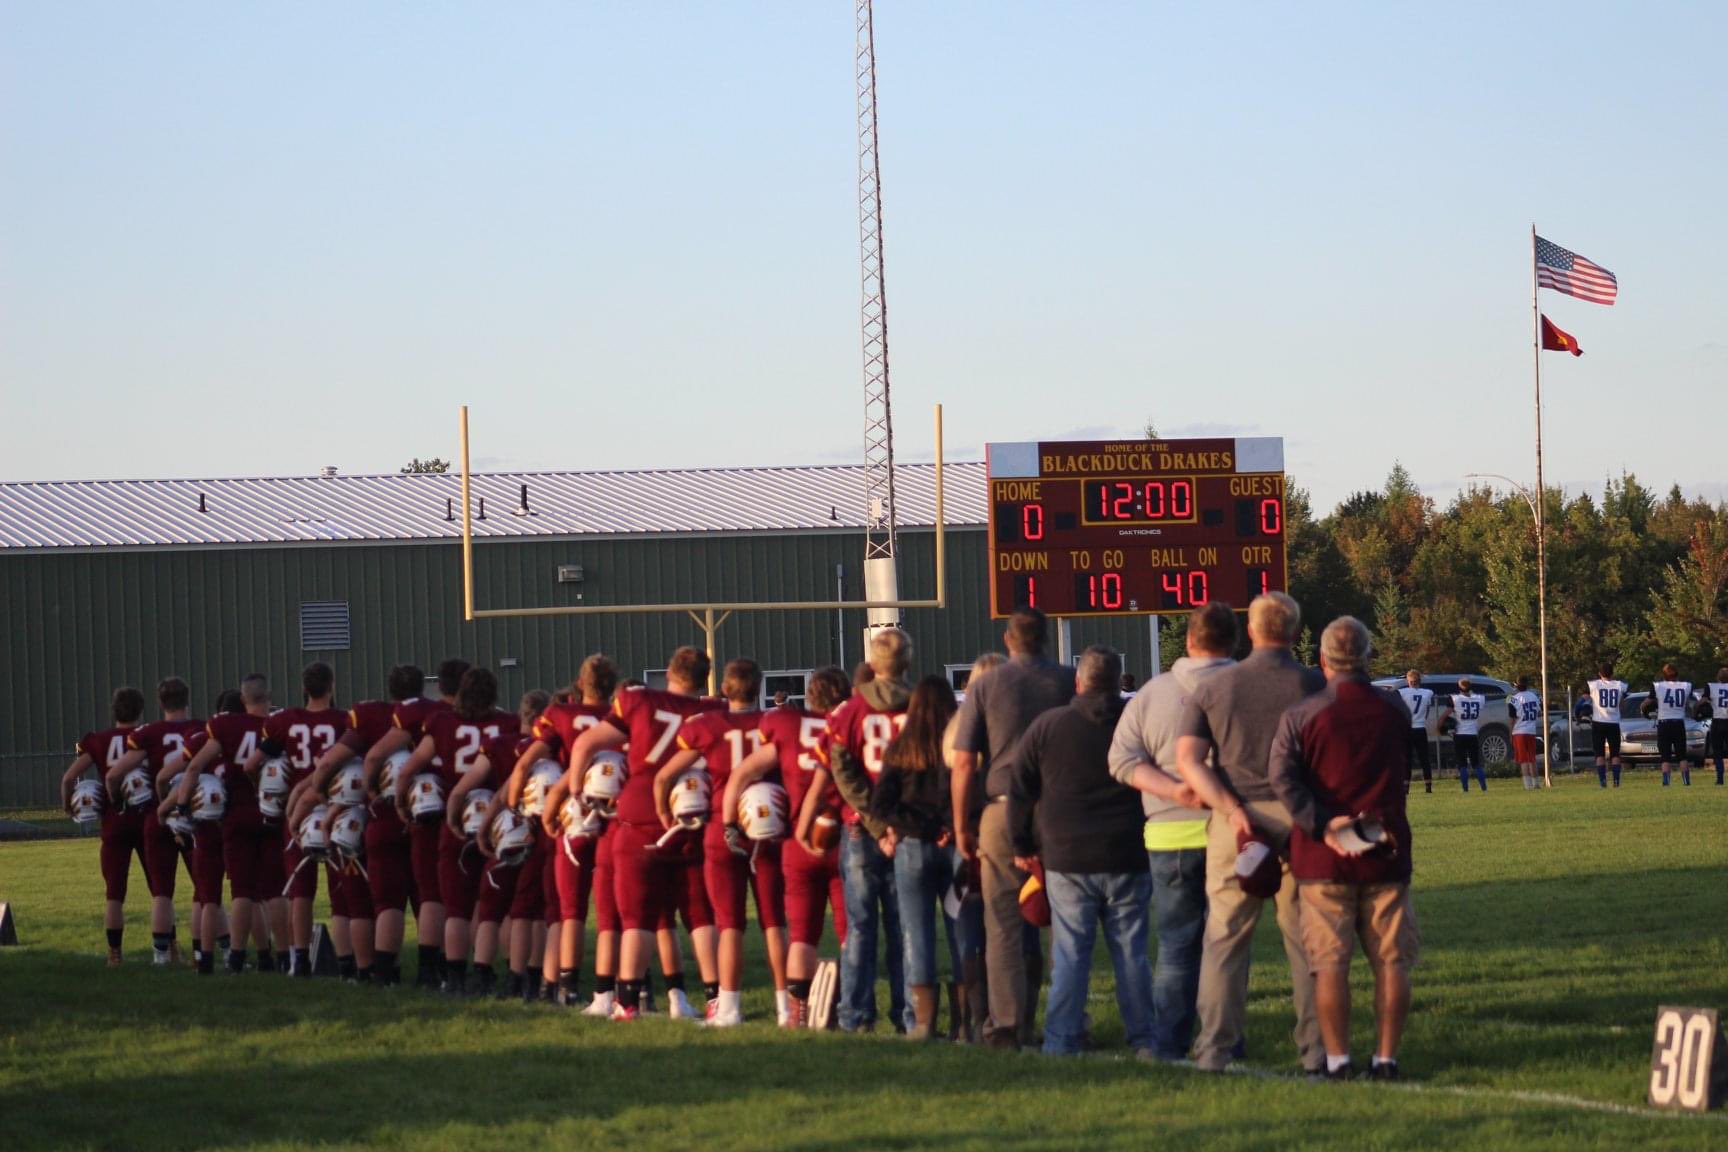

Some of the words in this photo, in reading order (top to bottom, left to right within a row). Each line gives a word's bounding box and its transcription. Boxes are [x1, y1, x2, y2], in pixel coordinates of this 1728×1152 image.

[1104, 444, 1133, 453] HOME
[1135, 444, 1149, 452] OF
[1151, 443, 1169, 452] THE
[1042, 453, 1153, 473] BLACKDUCK
[1160, 451, 1232, 470] DRAKES
[996, 482, 1042, 501] HOME
[1230, 477, 1283, 497] GUEST
[1101, 481, 1191, 519] 12:00
[1023, 504, 1043, 540] 0
[1261, 499, 1281, 535] 0
[1000, 551, 1048, 571] DOWN
[1070, 551, 1090, 569] TO
[1103, 550, 1124, 569] GO
[1151, 548, 1188, 568] BALL
[1199, 547, 1217, 566] ON
[1241, 546, 1272, 565] QTR
[1028, 577, 1035, 609] 1
[1090, 573, 1122, 610] 10
[1162, 570, 1208, 606] 40
[1413, 694, 1423, 714] 7
[1599, 688, 1619, 708] 88
[1664, 688, 1686, 708] 40
[1461, 701, 1480, 720] 33
[644, 709, 682, 763] 7
[1651, 1011, 1711, 1107] 30
